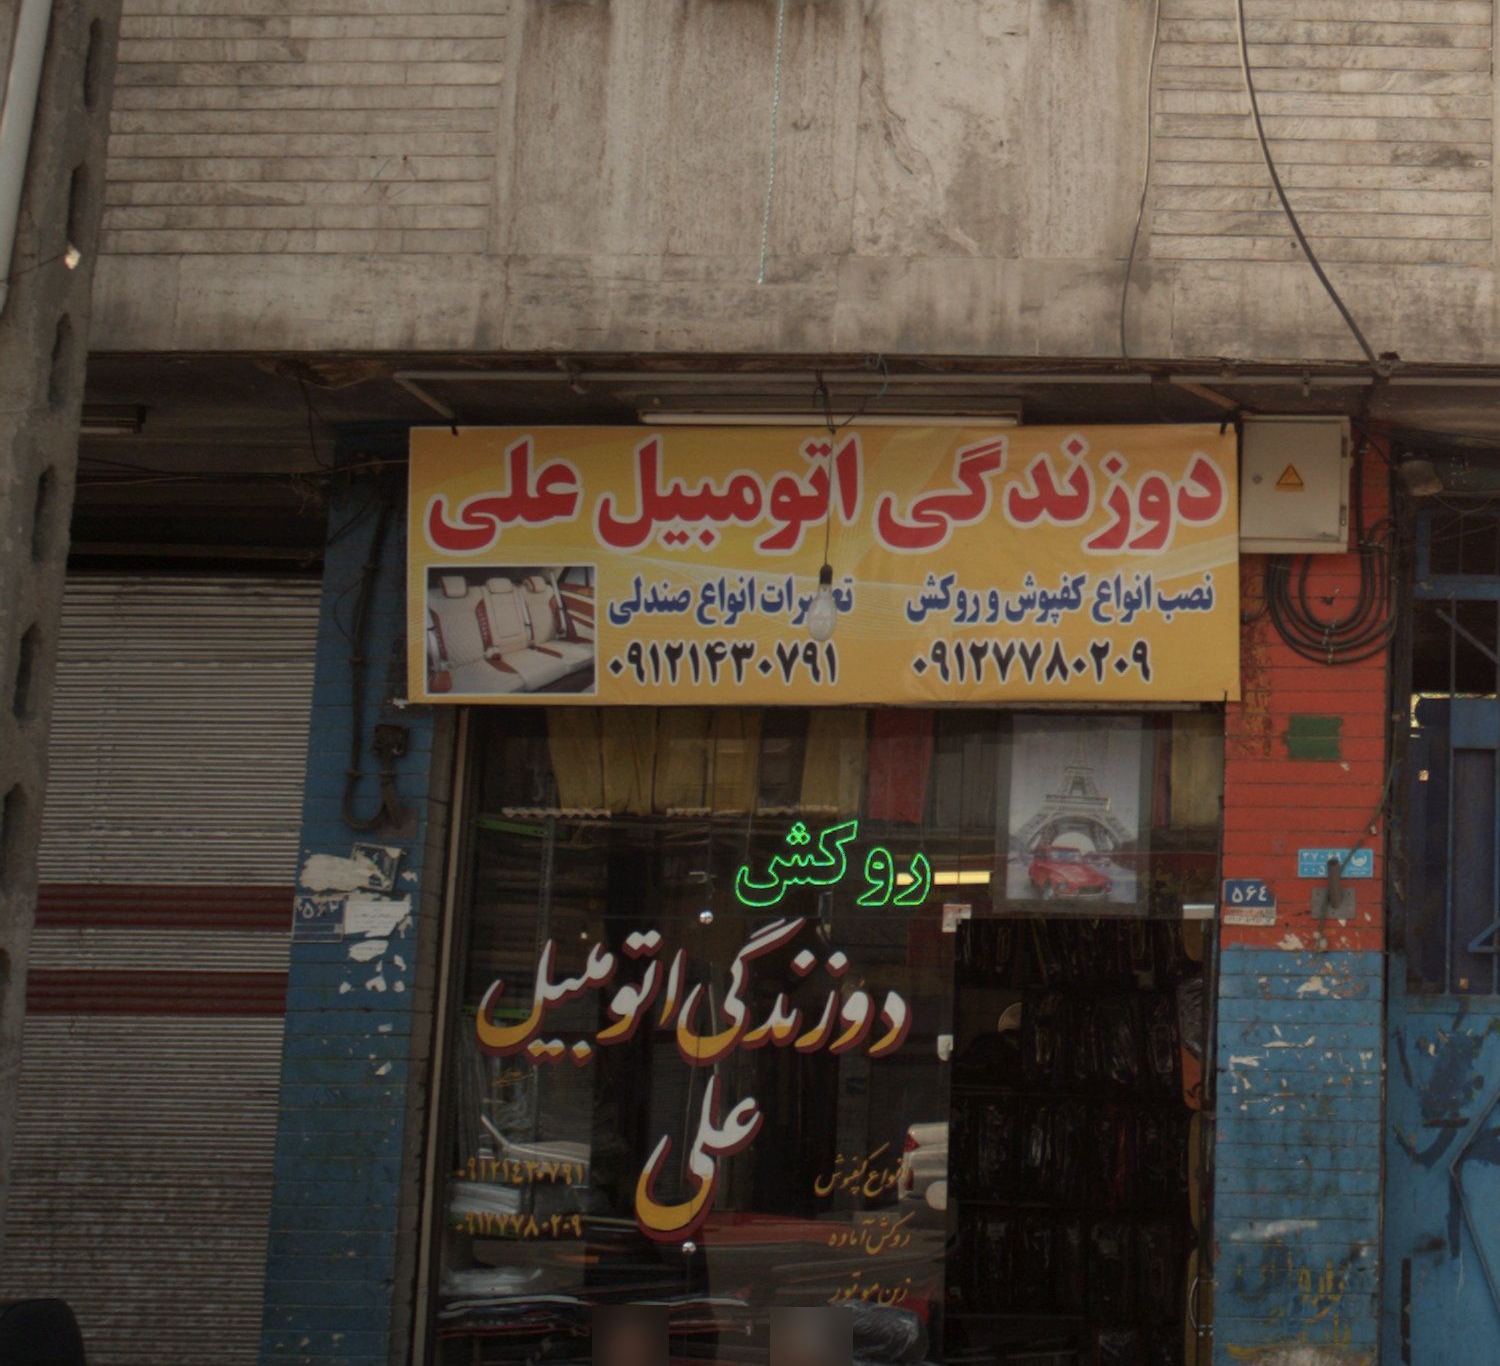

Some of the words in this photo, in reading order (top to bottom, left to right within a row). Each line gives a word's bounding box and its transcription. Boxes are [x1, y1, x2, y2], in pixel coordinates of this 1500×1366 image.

[427, 438, 580, 551] علی
[598, 437, 858, 551] اتومبیل
[876, 437, 1223, 551] دوزندگی
[609, 575, 692, 625] صندلی
[696, 575, 755, 625] انواع
[760, 575, 853, 625] تعیرات
[906, 574, 980, 624] روکش
[987, 596, 998, 624] و
[1004, 574, 1088, 625] کفپوش
[1092, 574, 1152, 624] انواع
[1157, 574, 1214, 623] نصب
[609, 641, 840, 684] ۰۹۱۲۱۴۳۰۷۹۱
[912, 639, 1151, 683] ۰۹۱۲۷۷۸۰۲۰۹
[735, 819, 932, 907] روکش
[475, 929, 688, 1067] اتومبیل
[677, 917, 912, 1067] دوزندگی
[635, 1073, 763, 1242] علی
[813, 1141, 891, 1199] کفپوش
[863, 1158, 912, 1199] انواع
[455, 1210, 583, 1239] ۰۹۱۲۷۷۸۰۲۰۹
[827, 1218, 876, 1248] آماده
[865, 1211, 916, 1256] روکش
[827, 1271, 880, 1305] موتور
[878, 1277, 912, 1307] زین
